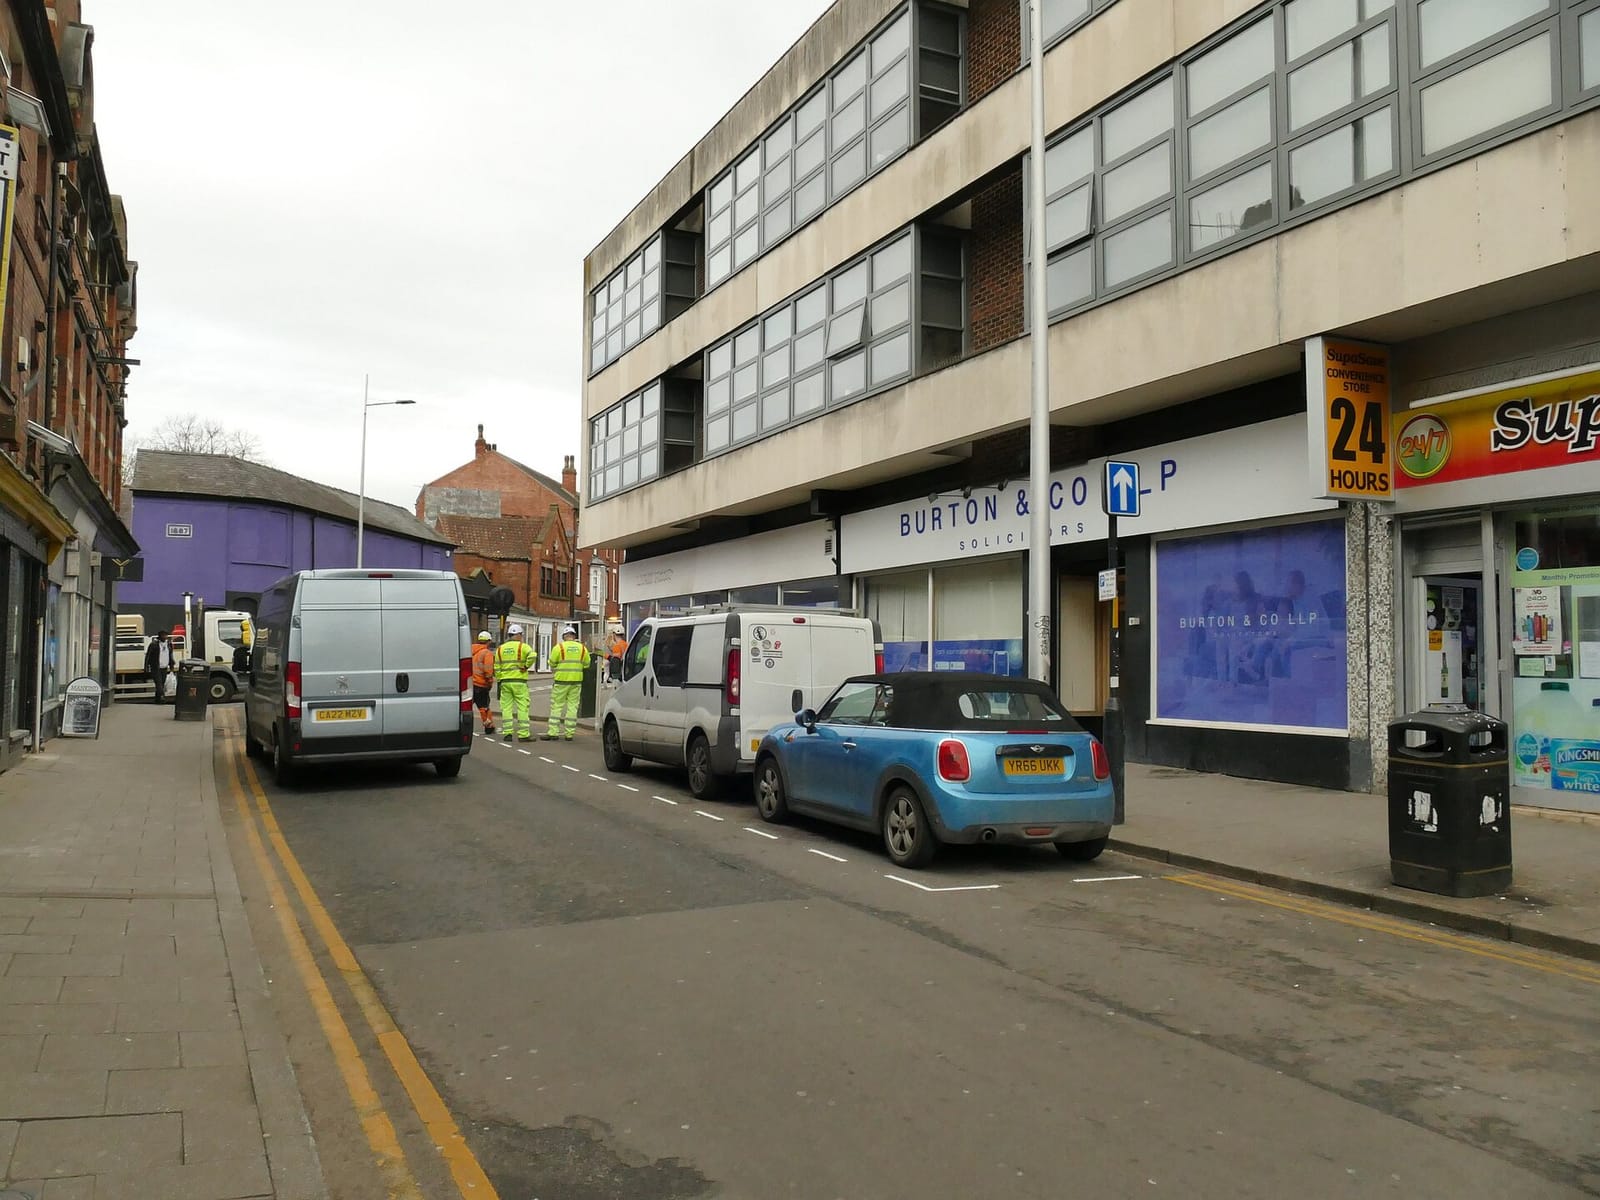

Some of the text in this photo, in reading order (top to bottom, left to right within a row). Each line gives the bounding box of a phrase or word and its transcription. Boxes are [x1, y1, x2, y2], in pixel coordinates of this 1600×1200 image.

[1343, 382, 1371, 393] STORE
[1331, 397, 1385, 463] 24
[1490, 396, 1600, 453] Sup
[1401, 428, 1447, 460] 24/7
[1330, 470, 1389, 492] HOURS
[900, 476, 1088, 536] BURTON & CO
[960, 522, 1084, 551] SOLICIRS
[1180, 612, 1317, 629] BURTON & CO LLP
[1008, 759, 1061, 771] YR66 UKK
